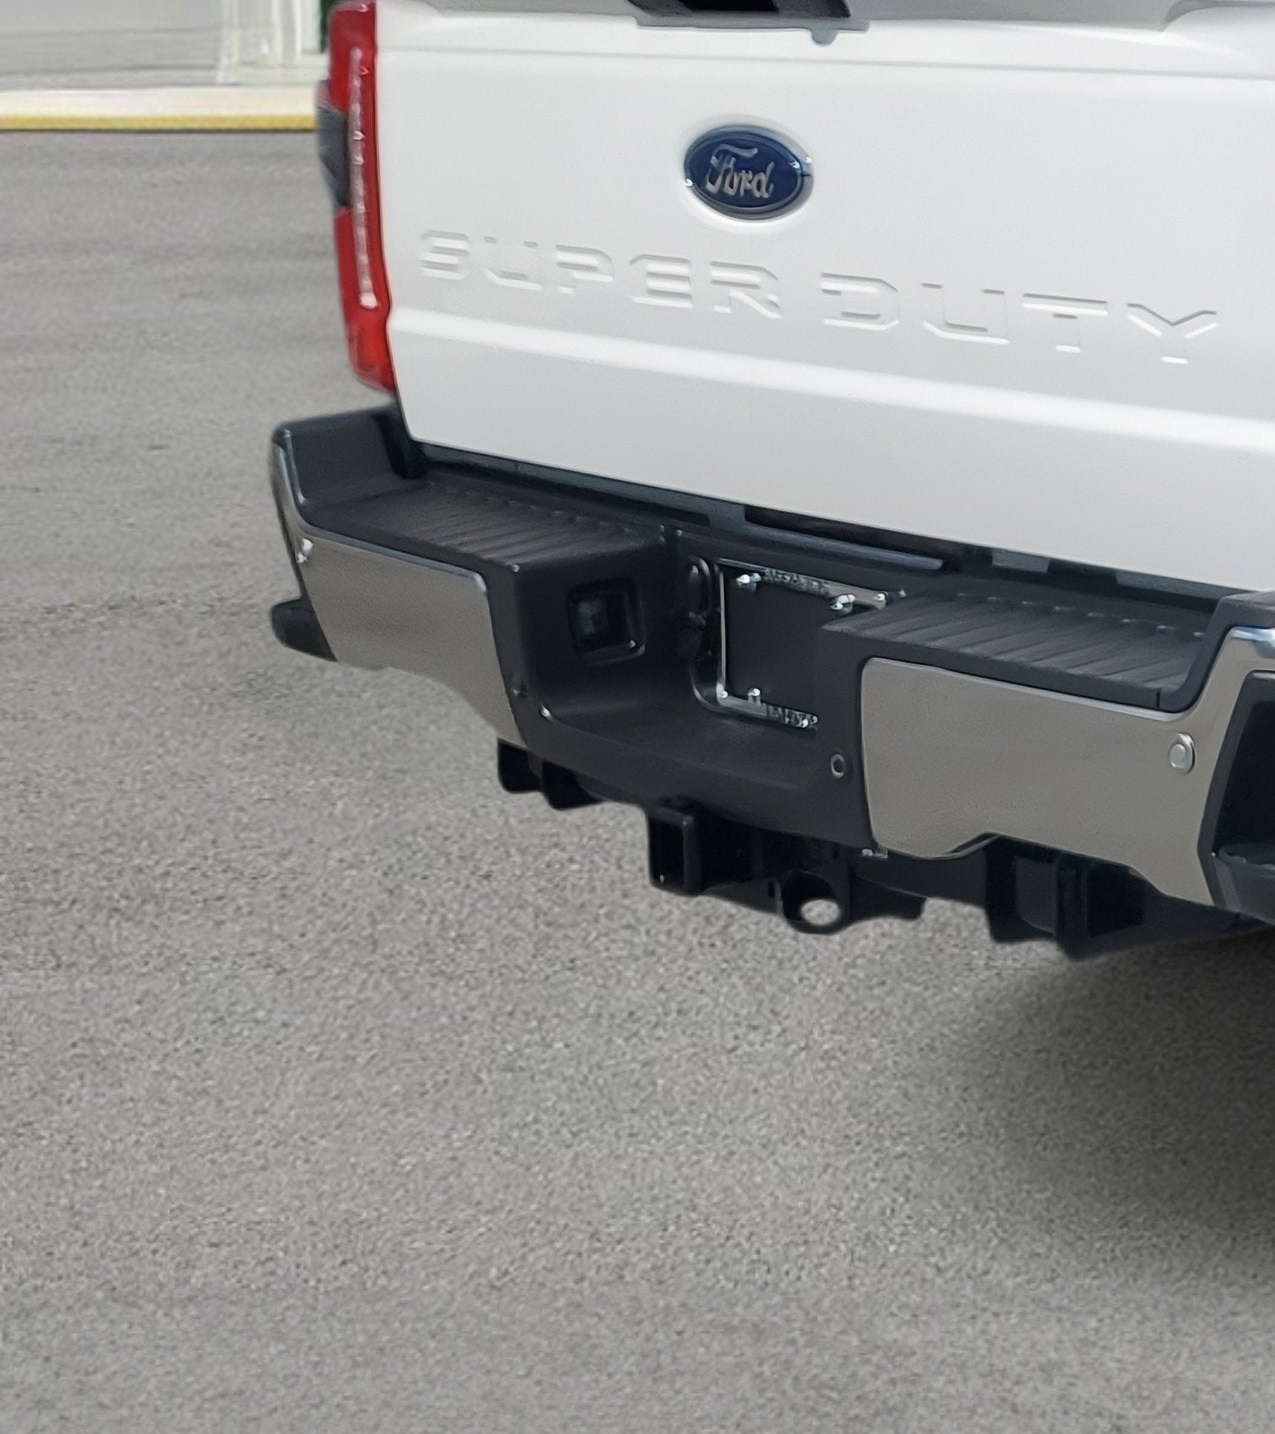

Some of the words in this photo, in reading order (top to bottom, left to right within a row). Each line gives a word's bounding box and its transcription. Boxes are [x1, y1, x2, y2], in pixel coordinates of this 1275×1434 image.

[706, 143, 775, 198] Ford
[419, 230, 783, 319] SUPER
[820, 271, 1219, 365] DUTY
